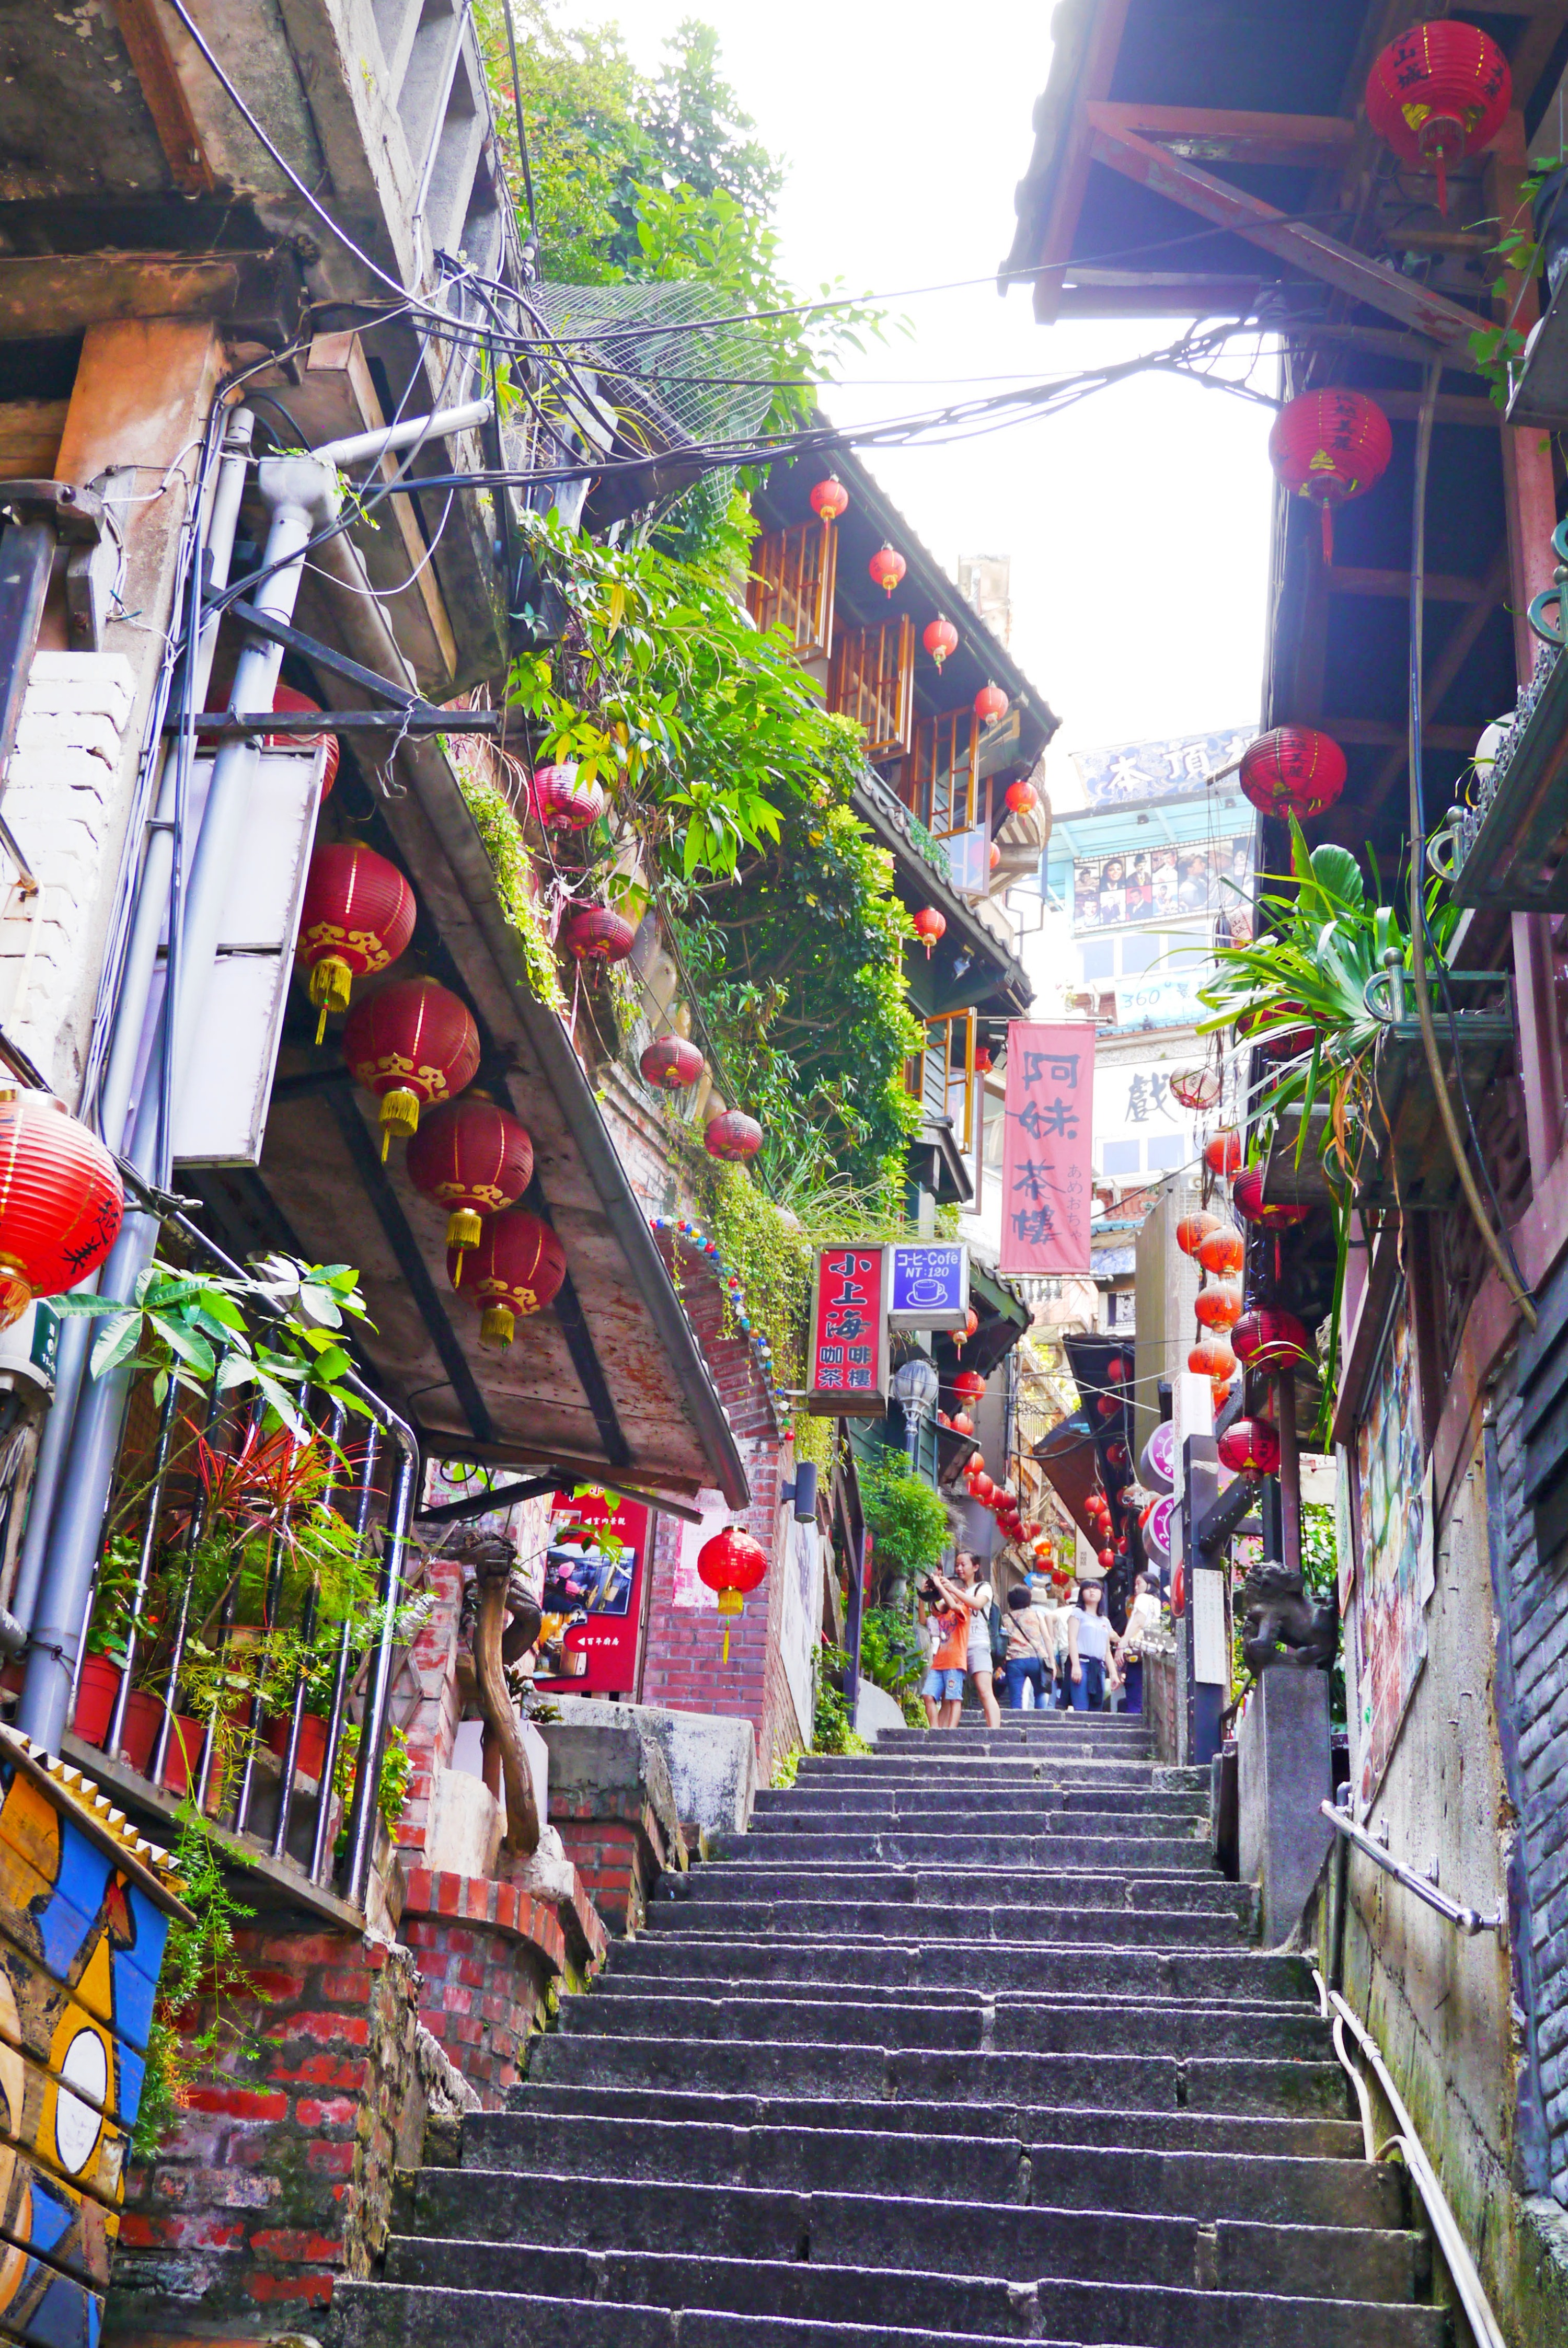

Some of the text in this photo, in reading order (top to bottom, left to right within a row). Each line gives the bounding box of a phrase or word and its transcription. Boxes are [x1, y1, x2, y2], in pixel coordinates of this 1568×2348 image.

[1005, 1050, 1081, 1245] 阿妹茶樓
[825, 1253, 873, 1341] 小上海
[819, 1368, 871, 1387] 茶樓
[820, 1345, 873, 1364] 咖啡
